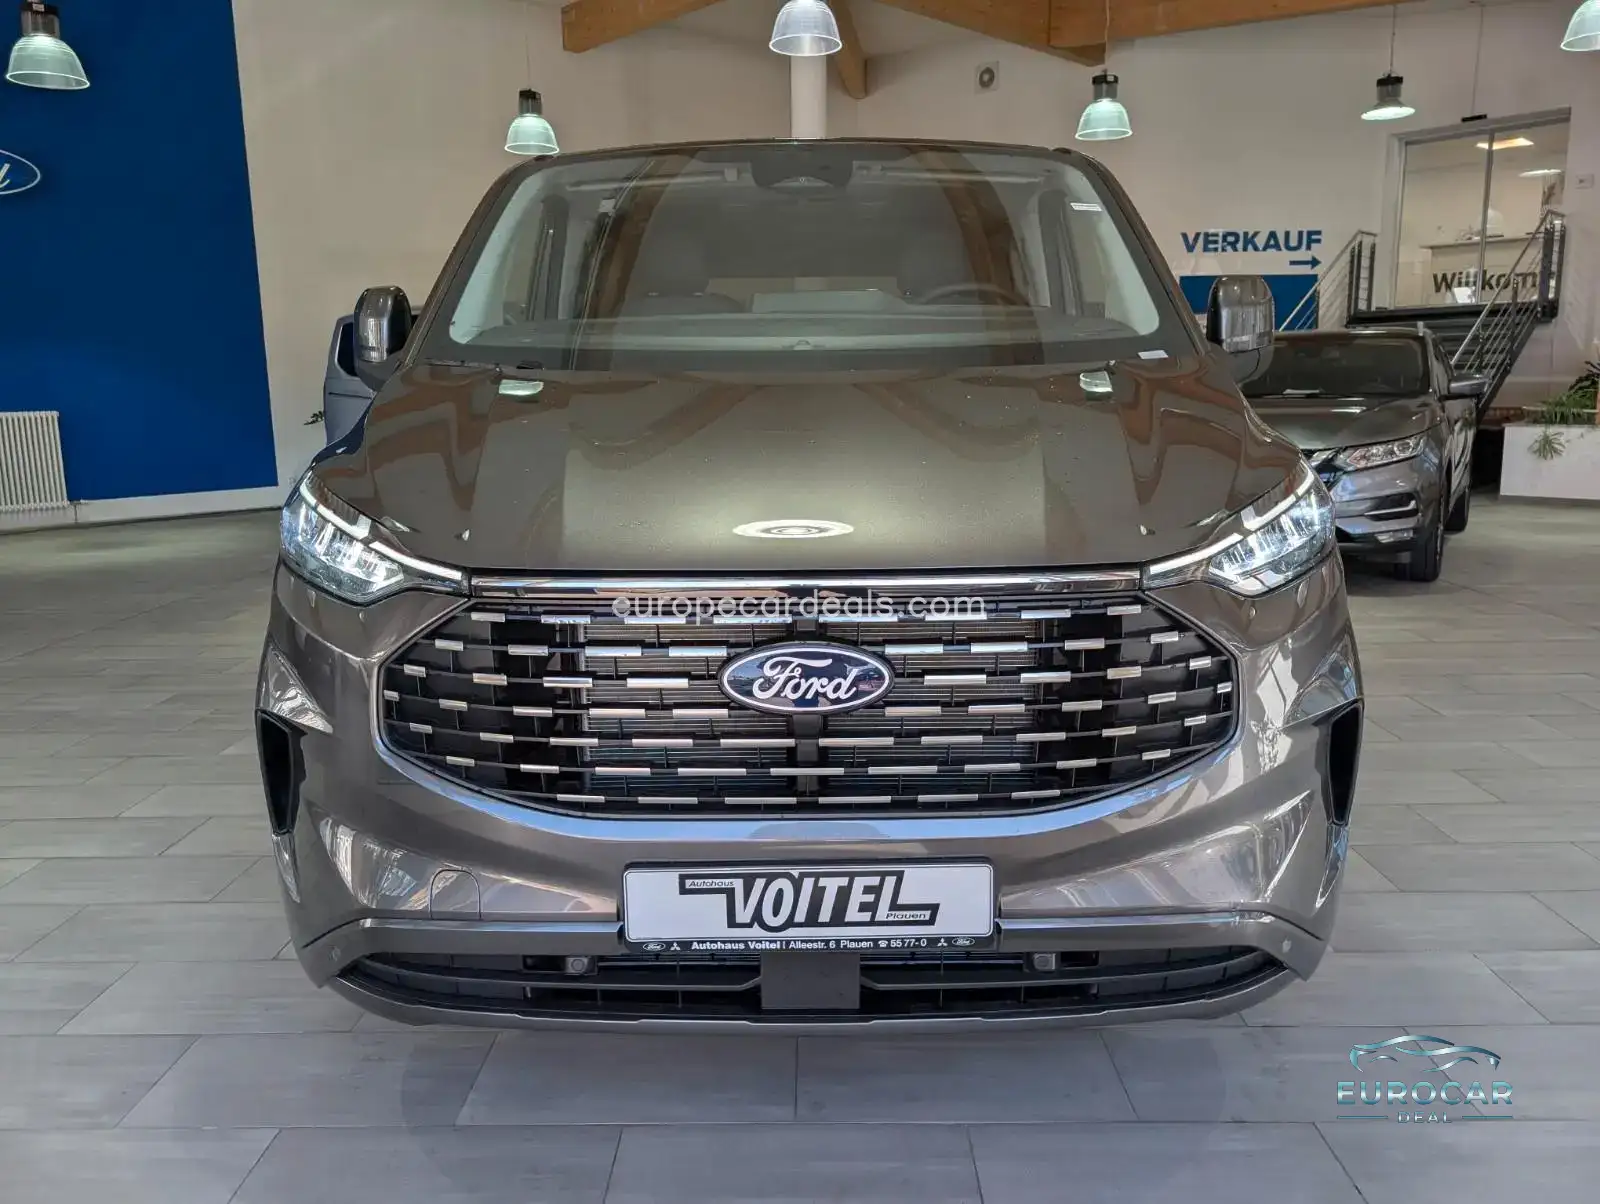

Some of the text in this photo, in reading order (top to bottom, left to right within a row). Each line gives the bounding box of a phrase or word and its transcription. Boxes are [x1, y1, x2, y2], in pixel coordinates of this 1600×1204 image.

[1181, 230, 1322, 253] VERKAUF
[752, 656, 857, 701] Ford
[688, 879, 735, 888] Autohaus
[735, 875, 897, 927] VOITEL
[885, 912, 926, 920] Plauen
[691, 941, 745, 950] Autohaus
[748, 940, 780, 949] Voitel
[788, 940, 827, 950] Alleestr.
[829, 941, 836, 949] 6
[840, 940, 873, 949] Plauen
